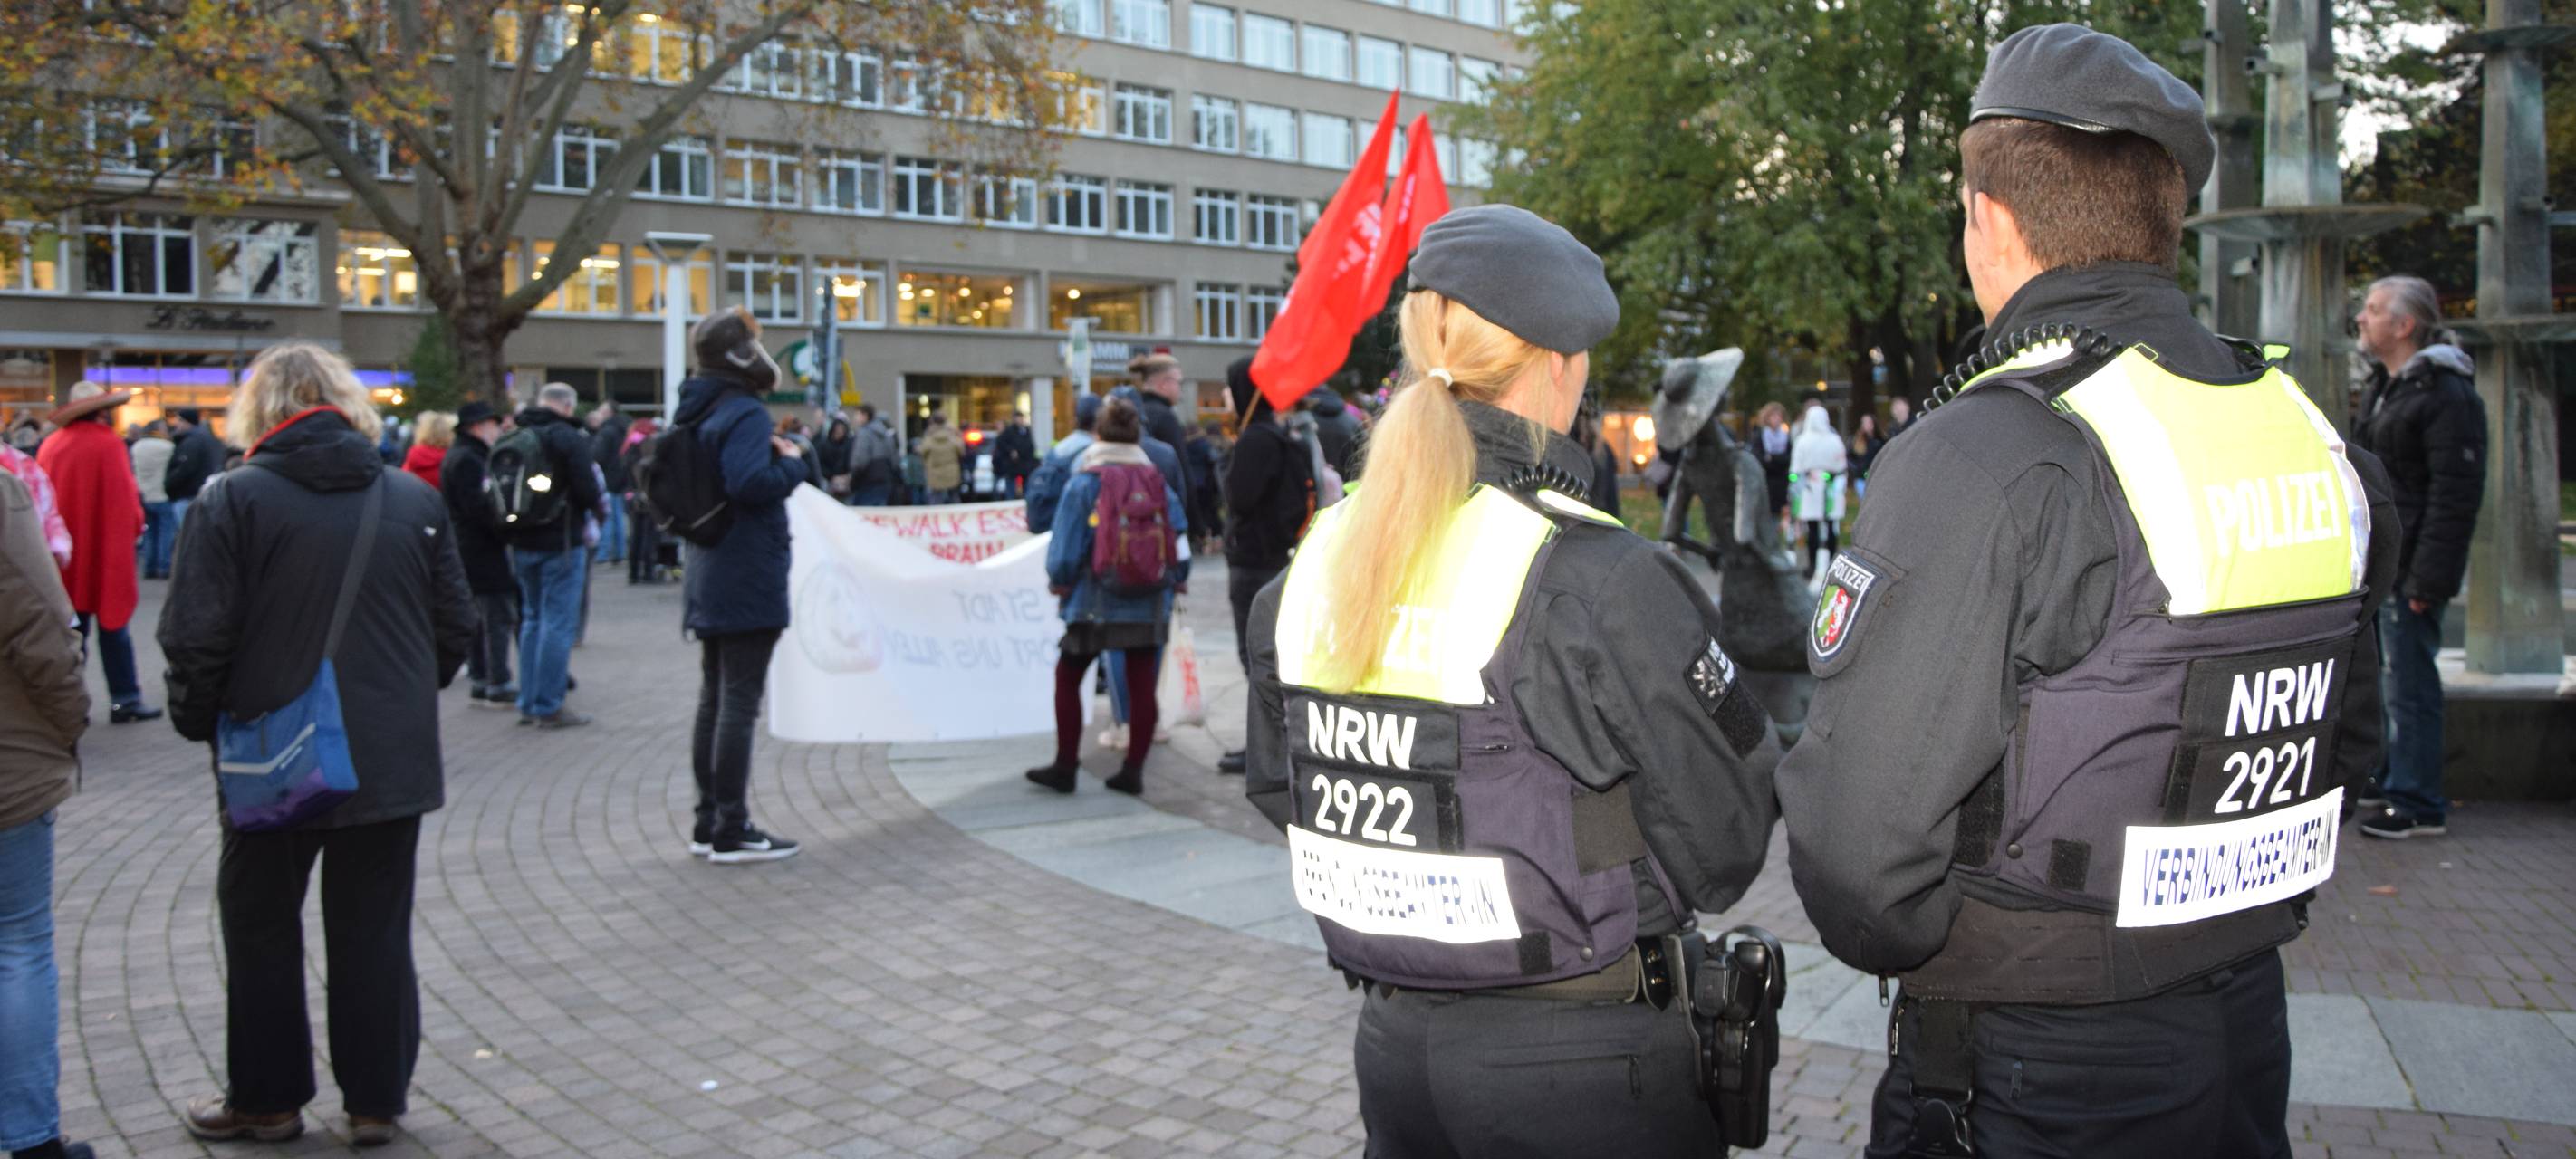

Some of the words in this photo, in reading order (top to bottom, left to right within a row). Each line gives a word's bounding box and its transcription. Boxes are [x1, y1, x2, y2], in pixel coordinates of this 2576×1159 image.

[2203, 470, 2342, 558] POLIZEI
[1831, 559, 1870, 592] POLIZEI
[2225, 658, 2334, 736] NRW
[1308, 701, 1417, 770] NRW
[1312, 773, 1417, 846] 2922
[2215, 736, 2316, 814] 2921
